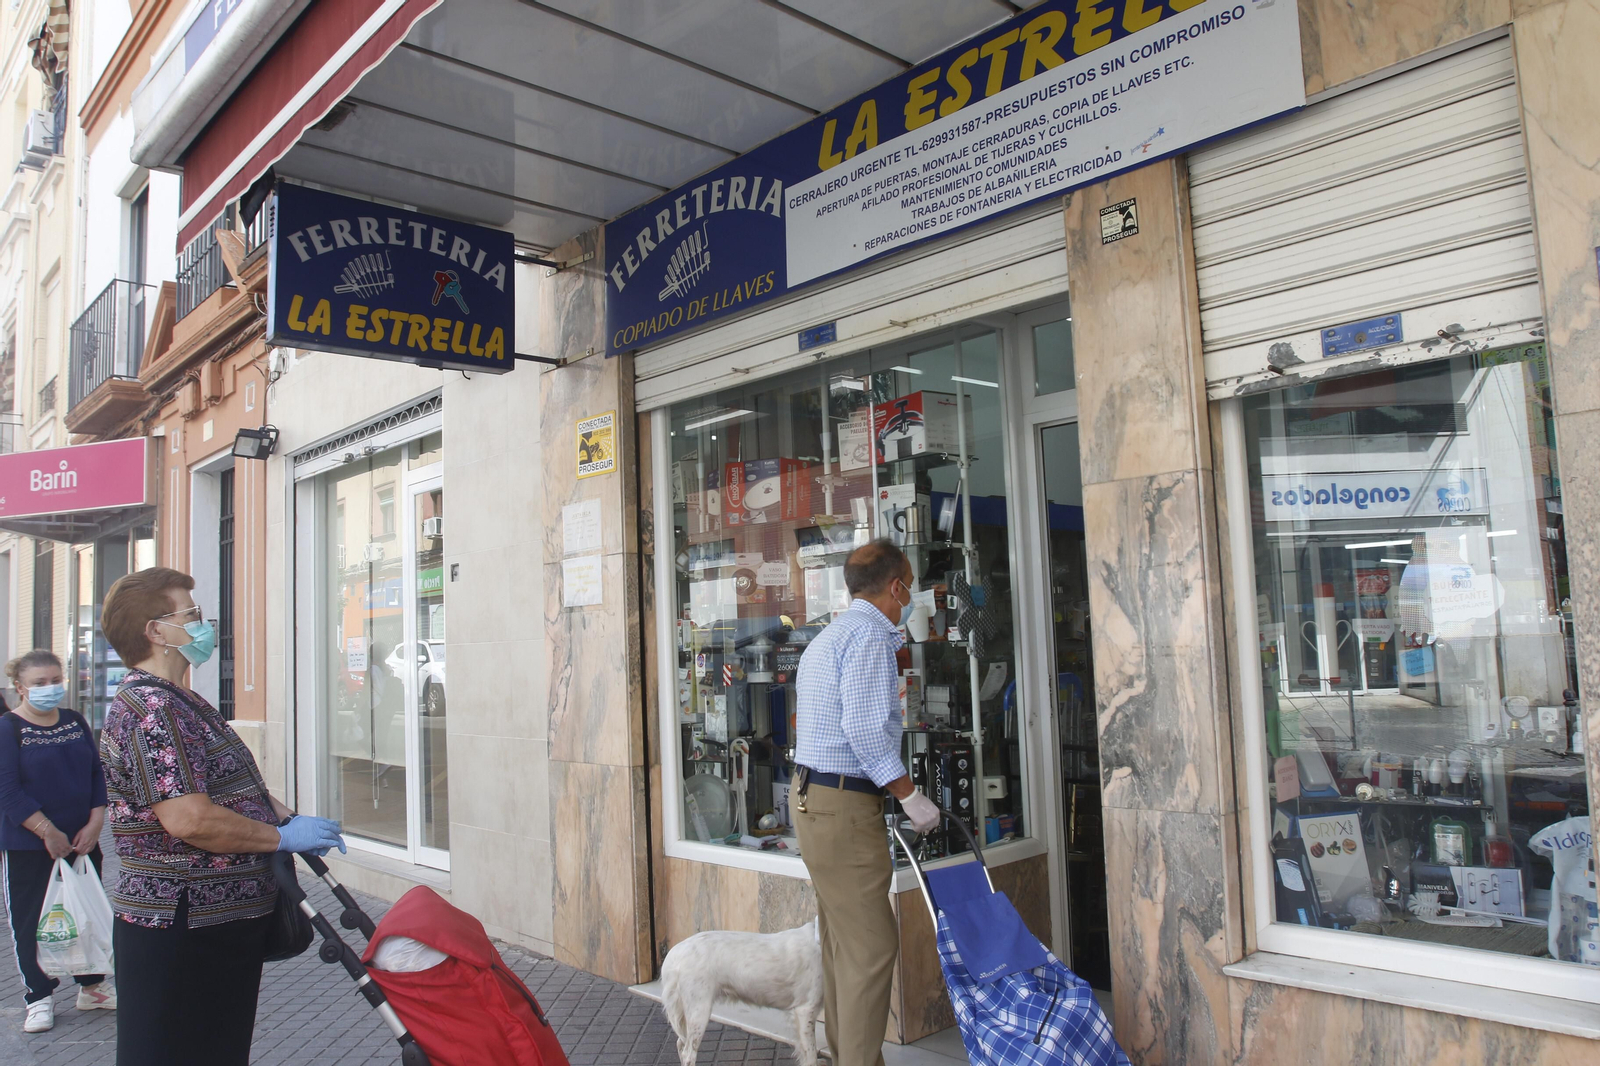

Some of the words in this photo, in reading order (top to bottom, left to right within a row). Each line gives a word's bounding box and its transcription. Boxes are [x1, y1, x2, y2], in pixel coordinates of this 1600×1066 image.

[789, 175, 848, 210] CERRAJERO
[850, 151, 901, 182] URGENTE
[1100, 55, 1126, 76] SIN
[1129, 5, 1245, 64] COMPROMISO
[815, 193, 860, 219] APERTURA
[861, 185, 873, 198] DE
[874, 167, 920, 193] PUERTAS,
[922, 146, 969, 173] MONTAJE
[971, 114, 1049, 153] CERRADURAS,
[1052, 97, 1090, 120] COPIA
[1092, 88, 1109, 105] DE
[1112, 67, 1161, 97] LLAVES
[1164, 55, 1195, 76] ETC.
[818, 99, 878, 172] LA
[861, 188, 900, 212] AFILADO
[902, 160, 972, 195] PROFESIONAL
[974, 153, 989, 167] DE
[991, 134, 1036, 161] TIJERAS
[1038, 129, 1046, 141] Y
[1048, 102, 1121, 137] CUCHILLOS.
[900, 170, 983, 209] MANTENIMIENTO
[986, 137, 1068, 178] COMUNIDADES
[911, 193, 965, 219] TRABAJOS
[968, 188, 982, 200] DE
[984, 157, 1057, 194] ALBAÑILERIA
[609, 176, 783, 293] FERRETERIA
[864, 217, 937, 251] REPARACIONES
[939, 212, 954, 225] DE
[956, 186, 1022, 218] FONTANERIA
[1024, 181, 1032, 193] Y
[1035, 150, 1122, 190] ELECTRICIDAD
[1100, 199, 1135, 215] CONECTADA
[287, 216, 507, 293] FERRETERIA
[1103, 228, 1138, 244] PROSEGUR
[287, 294, 331, 336] LA
[346, 304, 505, 360] ESTRELLA
[613, 306, 683, 349] COPIADO
[687, 295, 709, 321] DE
[712, 270, 775, 311] LLAVES
[578, 415, 612, 430] CONECTADA
[30, 460, 77, 492] Barin
[579, 459, 613, 474] PROSEGUR
[1307, 820, 1350, 839] ORYX
[1418, 883, 1449, 891] MANIVELA
